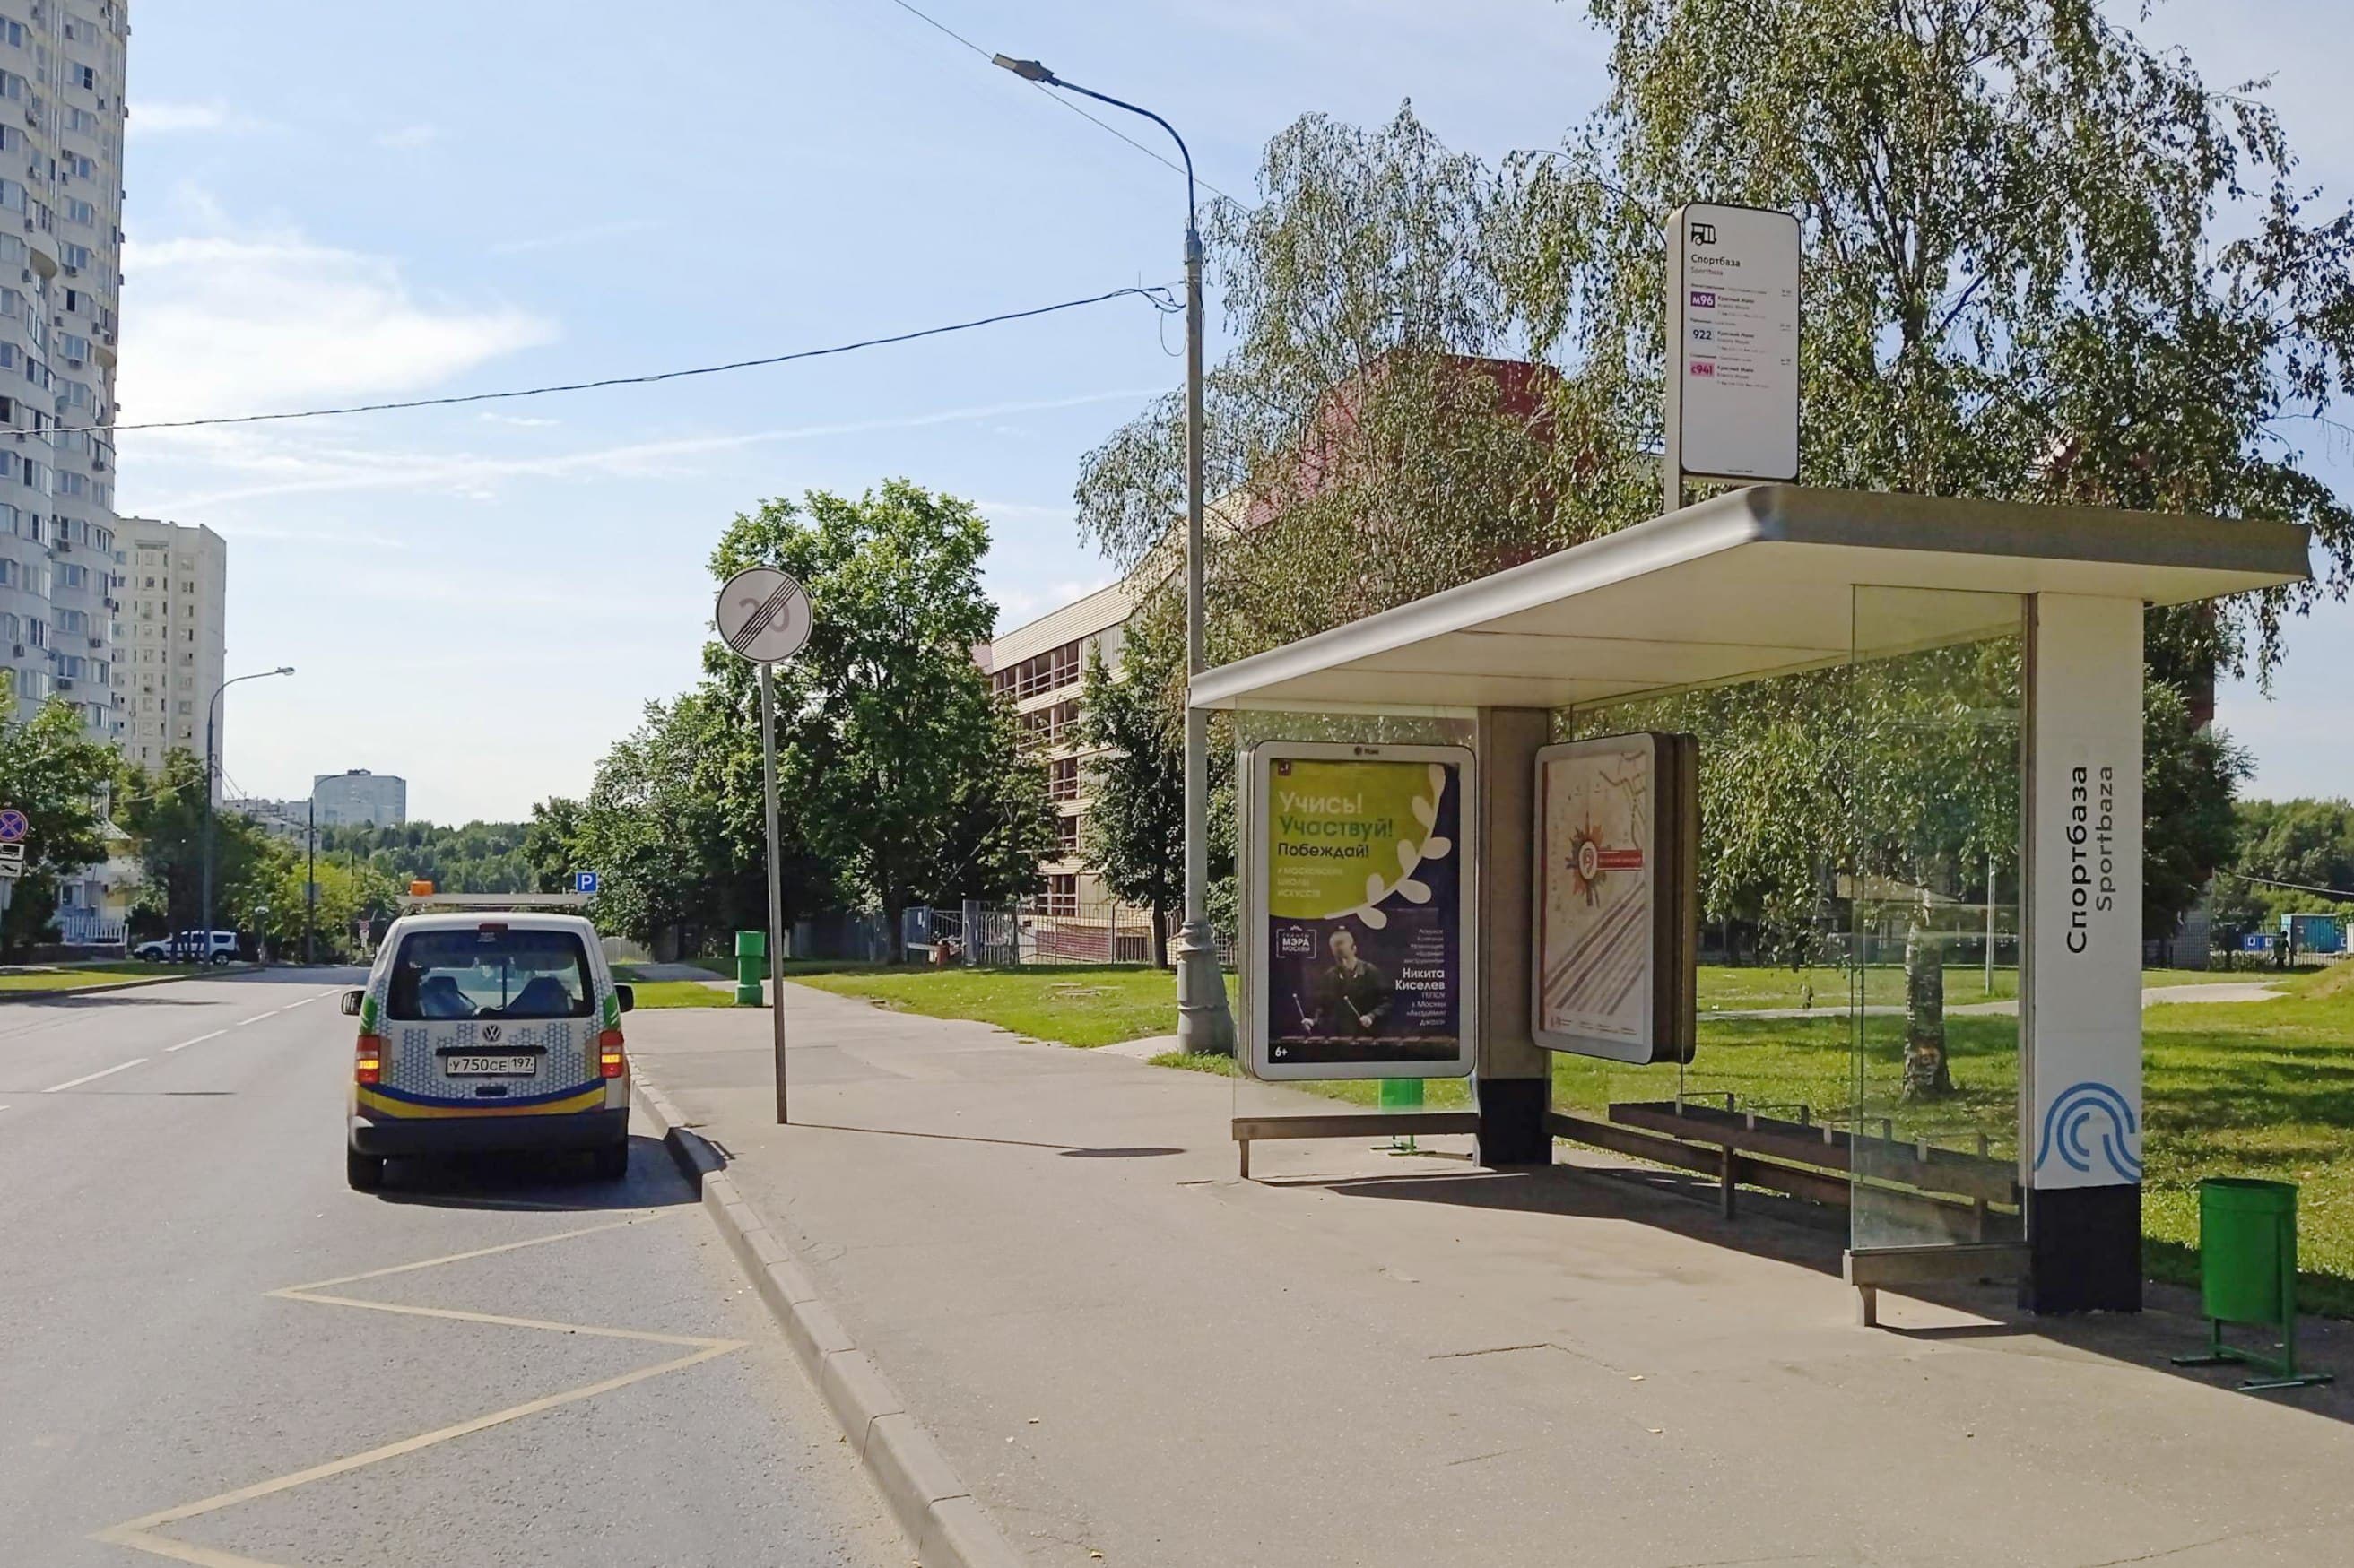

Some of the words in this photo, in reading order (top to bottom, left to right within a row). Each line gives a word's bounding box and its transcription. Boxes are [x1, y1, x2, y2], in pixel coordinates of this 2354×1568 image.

[1690, 254, 1741, 267] Спортбаза
[1692, 329, 1712, 340] 922
[1278, 791, 1363, 814] Учись!
[1279, 816, 1393, 841] Участвуй!
[2095, 767, 2116, 911] Sportbaza
[1278, 842, 1369, 859] Побеждай!
[2066, 767, 2091, 954] Спортбаза
[580, 874, 593, 891] P
[1282, 938, 1310, 946] МЭРА
[1403, 967, 1445, 978] Никита
[1395, 979, 1446, 990] Киселев
[1274, 1046, 1288, 1057] 6+
[511, 1058, 531, 1068] 197
